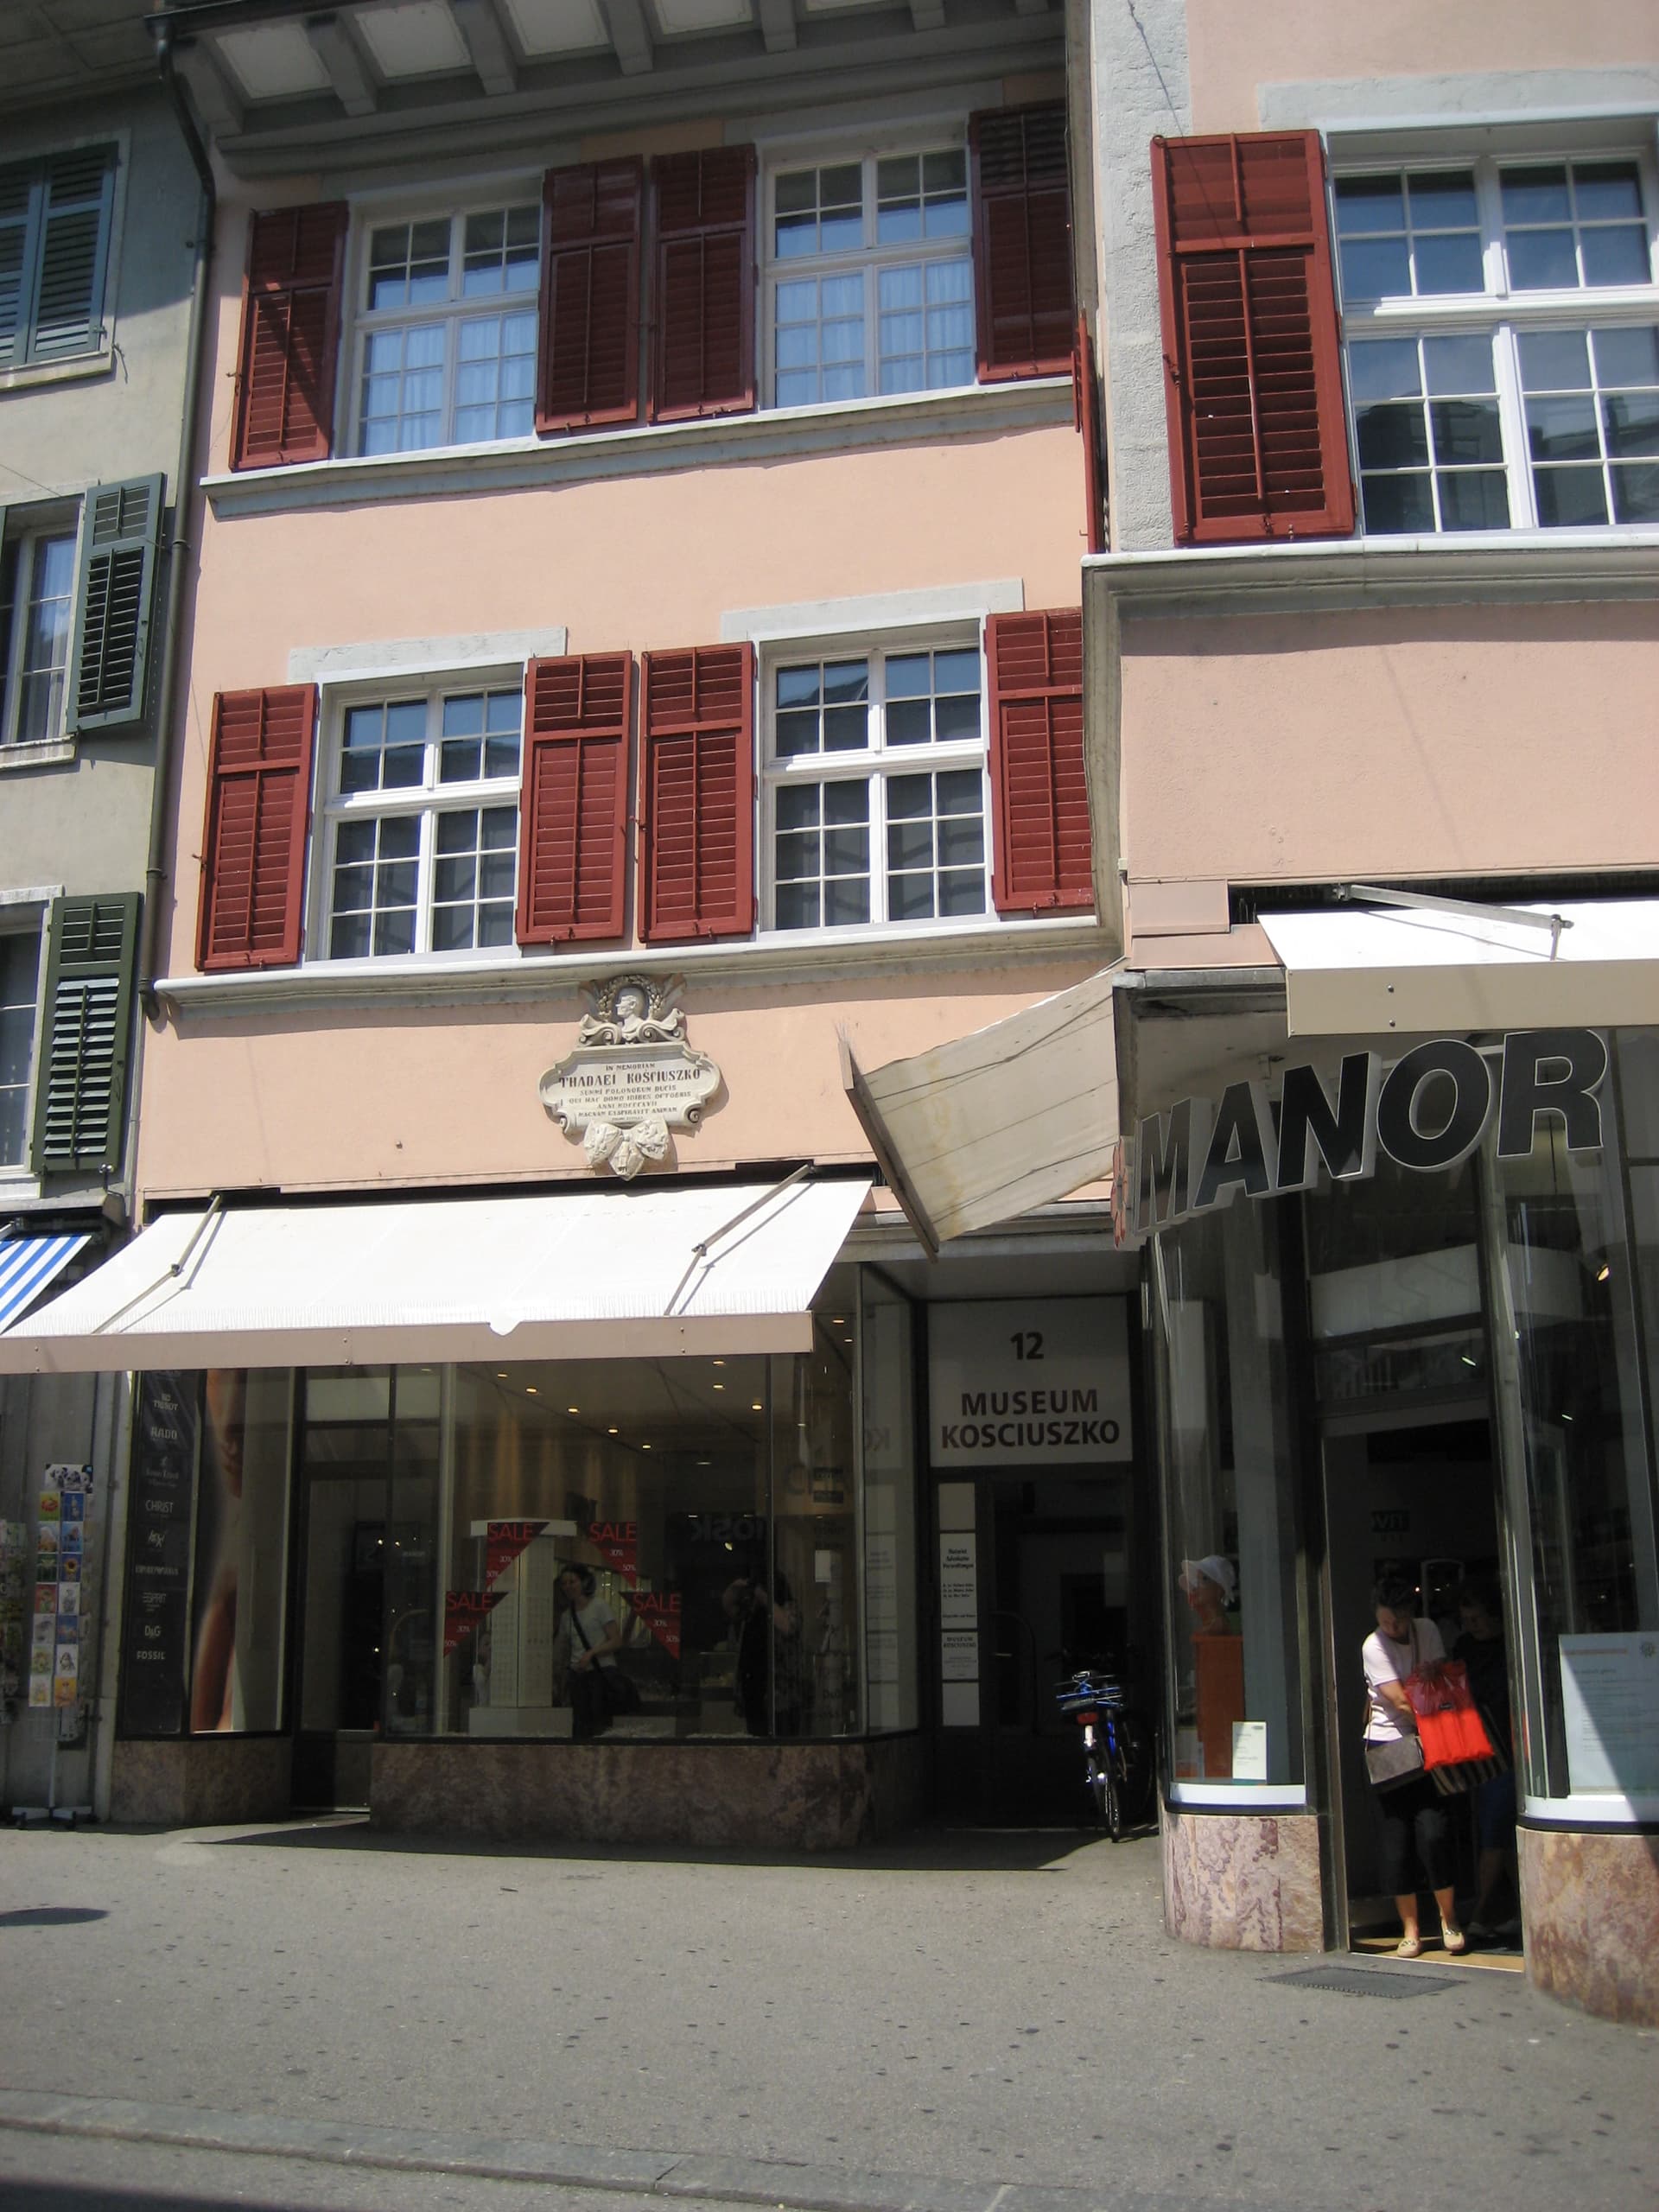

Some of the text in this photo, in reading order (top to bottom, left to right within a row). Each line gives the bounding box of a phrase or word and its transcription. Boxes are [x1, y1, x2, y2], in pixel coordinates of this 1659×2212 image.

[559, 1074, 616, 1088] THADAEI
[1134, 1030, 1607, 1234] MANOR
[1010, 1332, 1045, 1360] 12
[961, 1389, 1098, 1417] MUSEUM
[151, 1426, 178, 1440] RADO
[941, 1420, 1121, 1449] KOSCIUSZKO
[145, 1500, 174, 1514] CHRIST
[487, 1522, 533, 1541] SALE
[589, 1521, 637, 1542] SALE
[446, 1591, 493, 1611] SALE
[633, 1592, 681, 1612] SALE
[137, 1650, 167, 1660] FOSSIL
